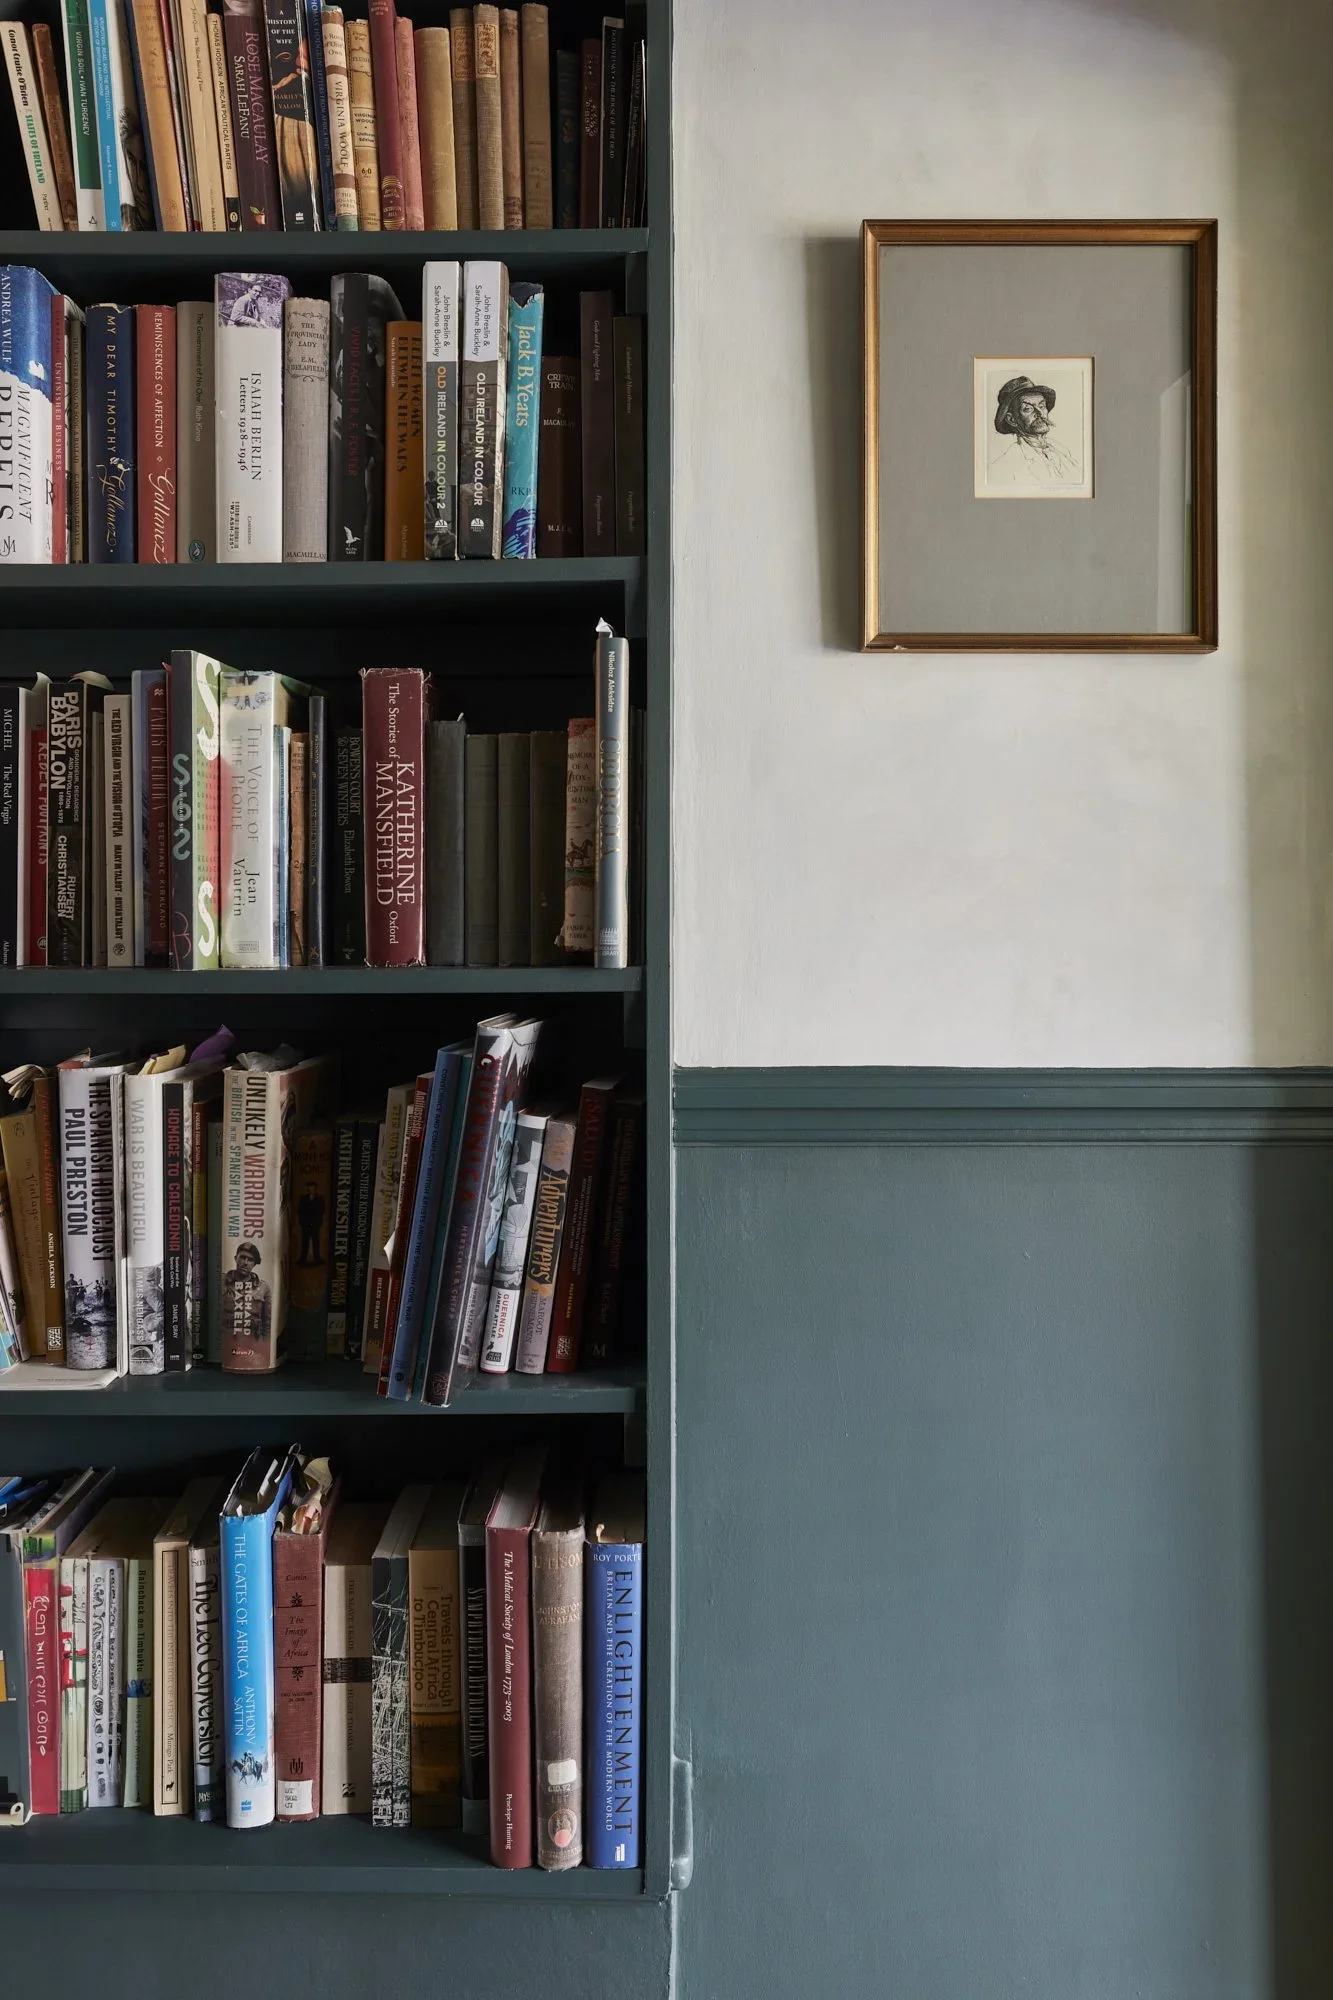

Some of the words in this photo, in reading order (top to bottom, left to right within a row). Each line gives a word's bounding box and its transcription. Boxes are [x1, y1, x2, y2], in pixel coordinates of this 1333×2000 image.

[8, 29, 17, 52] Conor
[76, 31, 84, 56] VIRGIN
[245, 32, 260, 71] ROSE
[12, 53, 22, 76] Cruise
[214, 48, 223, 76] HODGKIN
[234, 56, 246, 91] SARAH
[18, 78, 29, 106] O'Brien
[80, 81, 88, 97] IVAN
[216, 81, 225, 108] AFRICAN
[335, 81, 345, 127] VIRGINIA
[25, 115, 36, 138] STATES
[81, 99, 90, 135] TURGENEV
[219, 110, 228, 142] POLITICAL
[249, 76, 268, 164] MACAULAY
[30, 140, 39, 149] OF
[222, 144, 231, 170] PARTIES
[339, 132, 348, 167] WOOLF
[32, 151, 45, 183] IRELAND
[1, 274, 11, 323] ANDREA
[433, 286, 442, 325] Sarah-Anne
[474, 285, 482, 325] Sarah-Anne
[483, 295, 491, 308] John
[107, 316, 116, 333] MY
[431, 329, 442, 356] Buckley
[472, 329, 482, 356] Buckley
[483, 311, 491, 338] Breslin
[515, 323, 535, 359] Jack
[2, 328, 12, 364] WULF
[107, 345, 116, 377] DEAR
[154, 312, 164, 380] REMINISCENCES
[155, 384, 164, 395] OF
[436, 366, 446, 388] OLD
[475, 373, 485, 393] OLD
[517, 366, 535, 379] B.
[239, 377, 248, 413] Letters
[251, 373, 261, 421] ISAIAH
[516, 383, 533, 426] Yeats
[107, 390, 116, 452] TIMOTHY
[155, 399, 164, 447] AFFECTION
[436, 392, 446, 437] IRELAND
[475, 398, 485, 443] IRELAND
[17, 386, 32, 524] MAGNIFICENT
[55, 425, 63, 471] BUSINESS
[252, 427, 262, 480] BERLIN
[437, 441, 446, 451] IN
[474, 447, 484, 456] IN
[436, 455, 446, 499] COLOUR
[474, 461, 484, 505] COLOUR
[99, 465, 125, 546] Gollancz
[148, 468, 175, 564] Gollancz
[389, 683, 399, 704] The
[3, 709, 12, 750] MICHEL
[65, 691, 82, 747] PARIS
[389, 707, 399, 744] Stories
[50, 696, 66, 789] BABYLON
[232, 736, 243, 768] THE
[248, 725, 262, 757] THE
[389, 747, 399, 758] of
[3, 764, 12, 780] The
[3, 782, 12, 798] Red
[231, 775, 244, 831] PEOPLE
[247, 766, 262, 815] VOICE
[1, 800, 12, 824] Virgin
[248, 823, 259, 843] OF
[376, 761, 393, 905] MANSFIELD
[397, 761, 414, 905] KATHERINE
[58, 836, 67, 917] CHRISTIANSEN
[233, 859, 245, 916] Vautrin
[247, 871, 260, 903] Jean
[66, 876, 76, 920] RUPERT
[389, 911, 399, 944] Oxford
[89, 1082, 109, 1108] THE
[245, 1077, 265, 1149] UNLIKELY
[65, 1108, 85, 1151] PAUL
[131, 1099, 144, 1135] WAR
[168, 1108, 180, 1156] HOMAGE
[91, 1111, 112, 1173] SPANISH
[131, 1140, 145, 1154] IS
[337, 1128, 351, 1185] ARTHUR
[168, 1162, 180, 1176] TO
[66, 1157, 86, 1235] PRESTON
[131, 1161, 146, 1245] BEAUTIFUL
[244, 1154, 263, 1238] WARRIORS
[92, 1178, 114, 1261] HOLOCAUST
[168, 1183, 180, 1251] CALEDONIA
[334, 1189, 349, 1255] KOESTLER
[531, 1171, 567, 1283] Adventurers
[234, 1282, 243, 1335] BAXELL
[244, 1282, 252, 1335] RICHARD
[497, 1294, 509, 1339] GUERNICA
[491, 1316, 499, 1338] ATTLEE
[234, 1534, 246, 1559] THE
[505, 1552, 514, 1567] The
[194, 1578, 219, 1615] The
[235, 1563, 247, 1603] GATES
[504, 1570, 514, 1601] Medical
[605, 1571, 614, 1609] BRITAIN
[236, 1608, 247, 1625] OF
[414, 1599, 426, 1612] to
[441, 1595, 454, 1644] Travels
[503, 1604, 514, 1630] Society
[196, 1619, 220, 1654] Leo
[503, 1633, 514, 1641] of
[605, 1614, 613, 1634] AND
[236, 1629, 248, 1678] AFRICA
[504, 1644, 513, 1674] London
[605, 1638, 613, 1655] THE
[427, 1657, 440, 1700] Africa
[605, 1660, 613, 1707] CREATION
[196, 1660, 219, 1766] Conversion
[234, 1697, 244, 1736] SATTIN
[244, 1686, 255, 1744] ANTHONY
[605, 1712, 613, 1725] OF
[613, 1571, 633, 1834] ENLIGHTENMENT
[605, 1729, 613, 1746] THE
[605, 1751, 613, 1792] MODERN
[504, 1794, 513, 1822] Penelope
[605, 1796, 613, 1831] WORLD
[504, 1824, 513, 1849] Hunting
